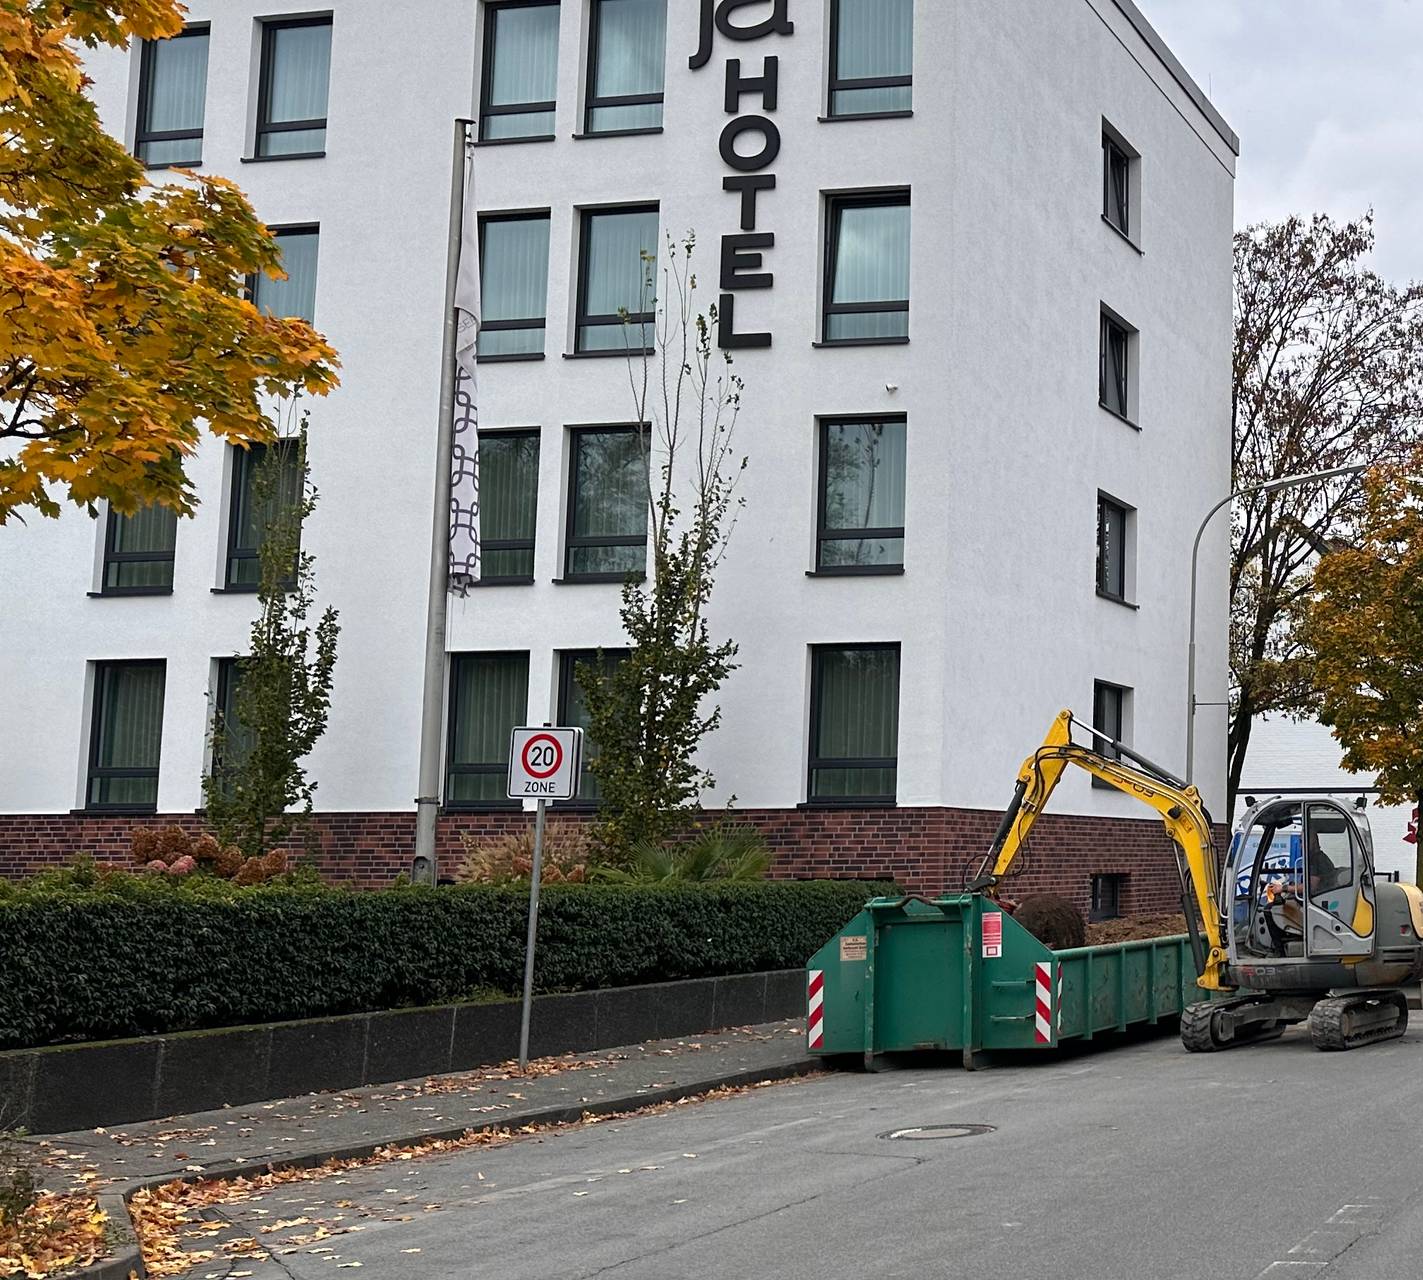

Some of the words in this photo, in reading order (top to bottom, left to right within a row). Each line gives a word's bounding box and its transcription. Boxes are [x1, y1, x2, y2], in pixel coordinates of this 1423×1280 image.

[718, 56, 781, 348] HOTEL
[530, 746, 555, 767] 20
[524, 781, 556, 793] ZONE
